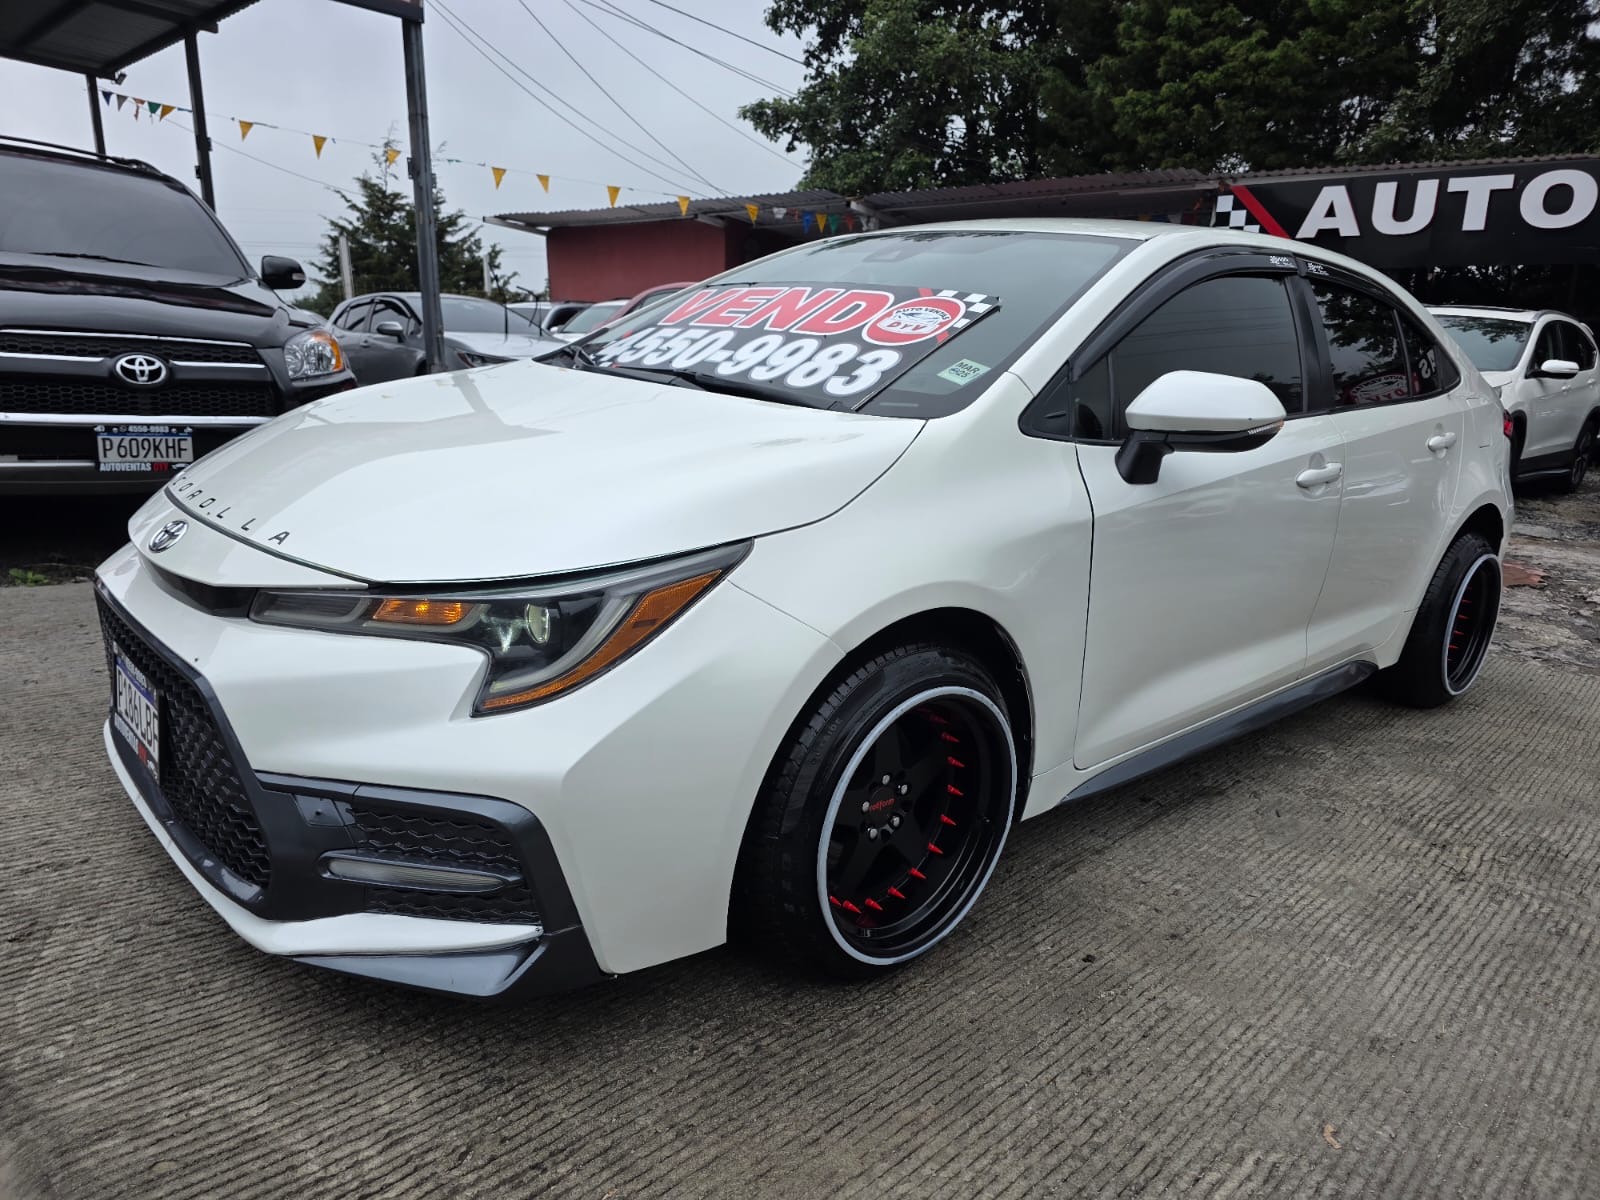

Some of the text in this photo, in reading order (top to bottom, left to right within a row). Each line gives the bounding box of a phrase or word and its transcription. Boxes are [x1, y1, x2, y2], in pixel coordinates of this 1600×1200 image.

[1295, 169, 1599, 238] AUTO
[924, 307, 950, 320] VENTAS
[598, 327, 901, 396] 4550-9983
[955, 361, 980, 374] MAR
[100, 463, 152, 472] AUTOVENTAS
